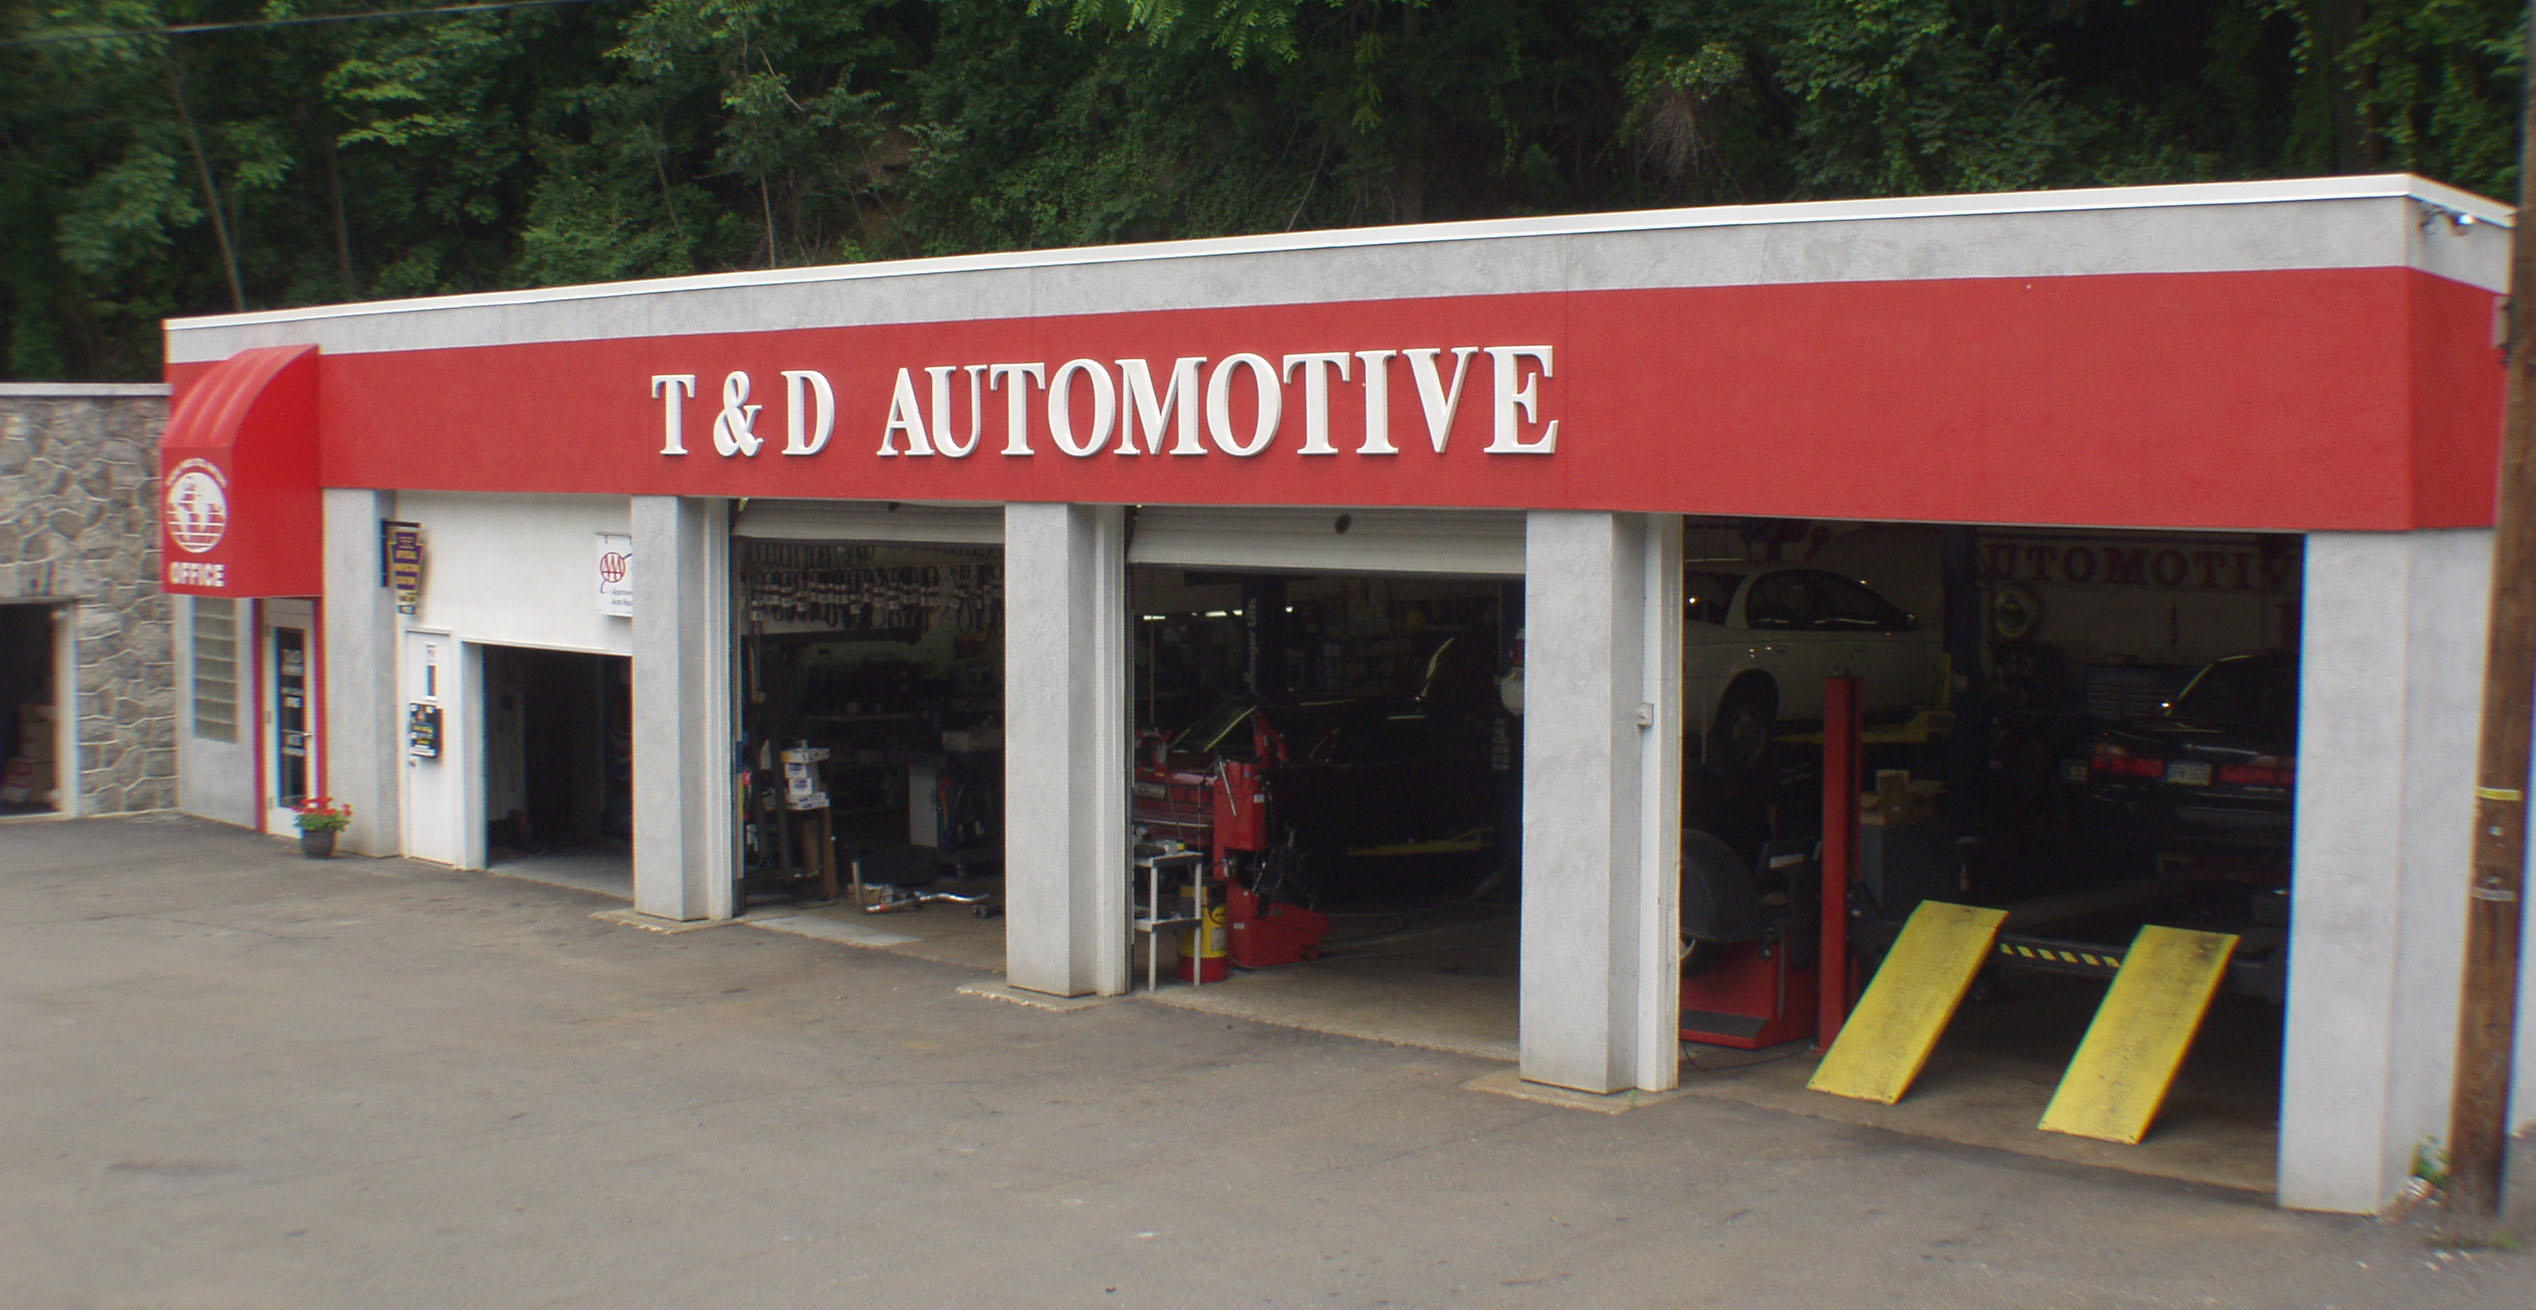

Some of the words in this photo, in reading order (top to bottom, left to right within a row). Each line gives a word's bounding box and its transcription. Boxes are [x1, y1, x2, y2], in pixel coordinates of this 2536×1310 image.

[651, 374, 696, 456] T
[713, 370, 764, 457] &
[780, 369, 836, 456] D
[876, 344, 1559, 458] AUTOMOTIVE
[170, 561, 226, 587] OFFICE
[1978, 544, 2297, 590] UTOMOTIV
